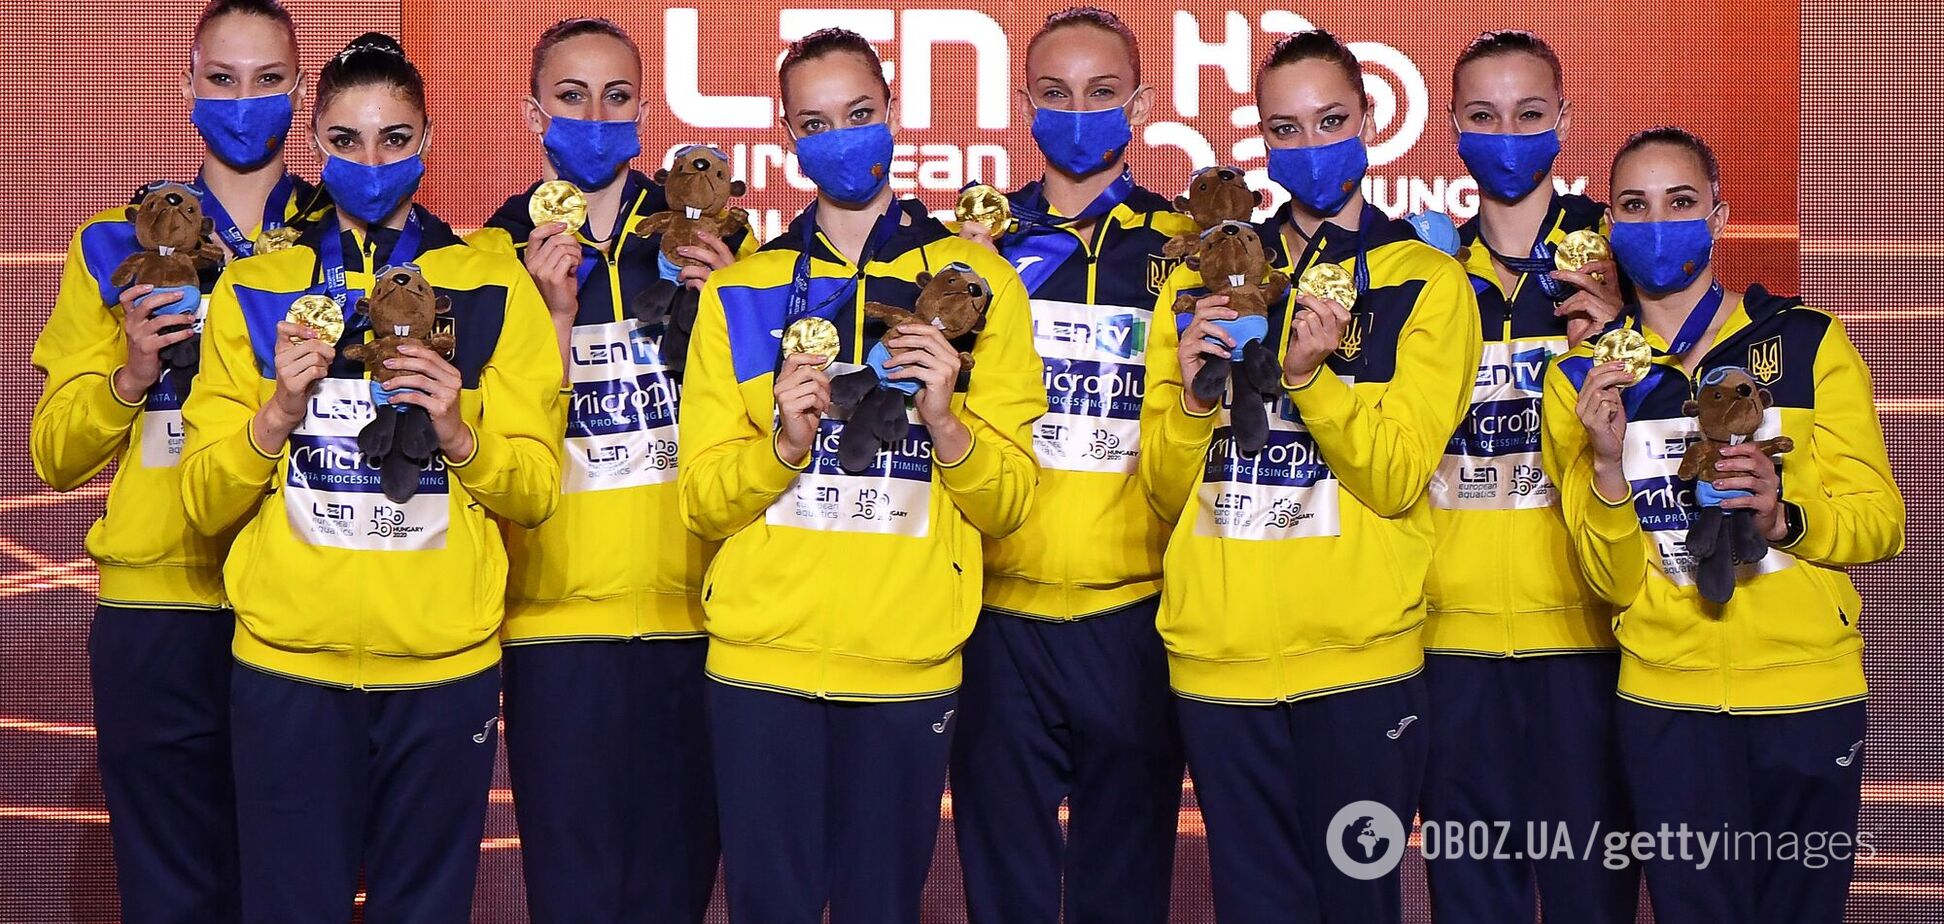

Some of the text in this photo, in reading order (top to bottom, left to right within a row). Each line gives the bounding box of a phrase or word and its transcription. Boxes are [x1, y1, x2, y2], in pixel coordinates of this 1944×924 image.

[1474, 361, 1543, 386] EN TV
[1460, 467, 1498, 482] LEN
[313, 502, 354, 520] LEN
